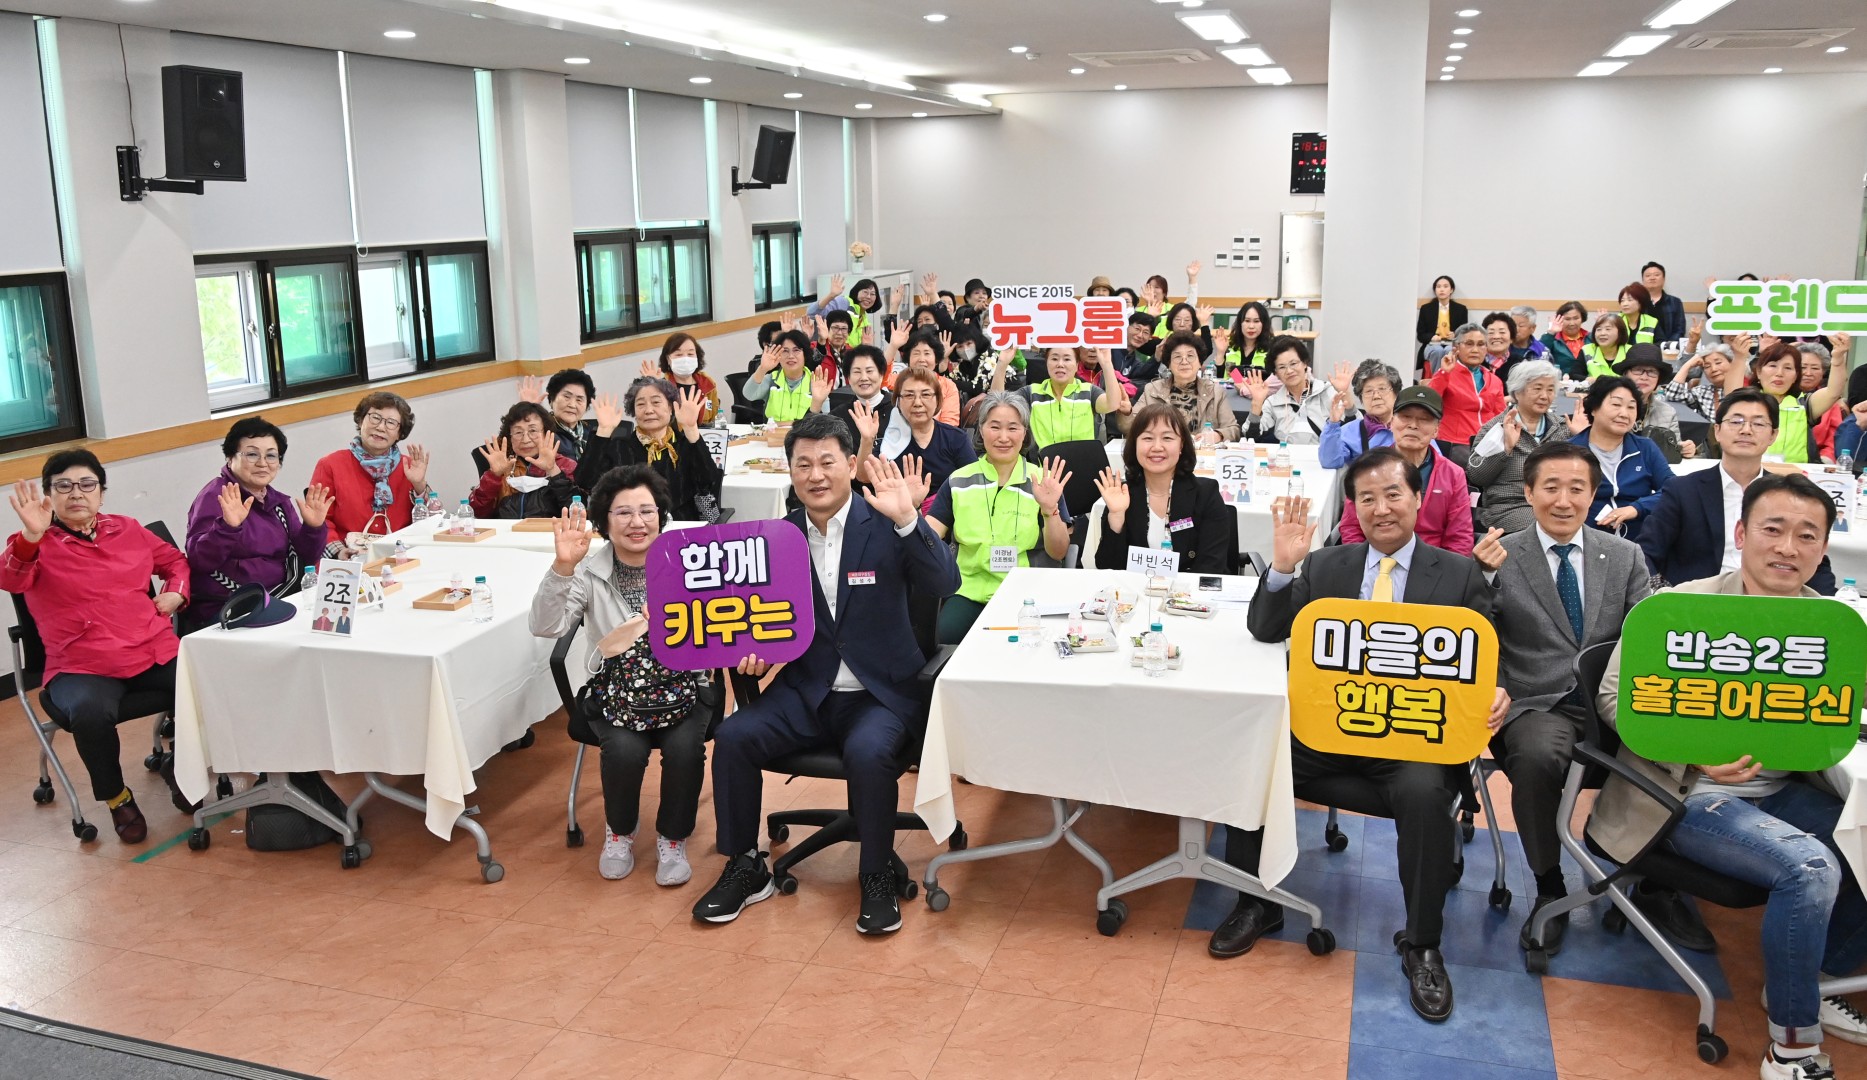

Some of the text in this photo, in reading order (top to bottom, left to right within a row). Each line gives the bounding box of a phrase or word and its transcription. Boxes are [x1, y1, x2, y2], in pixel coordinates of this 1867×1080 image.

[993, 286, 1073, 299] SINCE 2015
[1711, 283, 1867, 333] 프렌드
[991, 301, 1125, 346] 뉴그룹
[1222, 465, 1248, 480] 5조
[679, 536, 769, 590] 함께
[1131, 552, 1173, 571] 내빈석
[324, 582, 351, 605] 2조
[664, 594, 794, 648] 키우는
[1313, 619, 1476, 683] 마을의
[1666, 630, 1827, 676] 반송2동
[1335, 681, 1445, 742] 행복
[1631, 675, 1854, 726] 홀몸어르신
